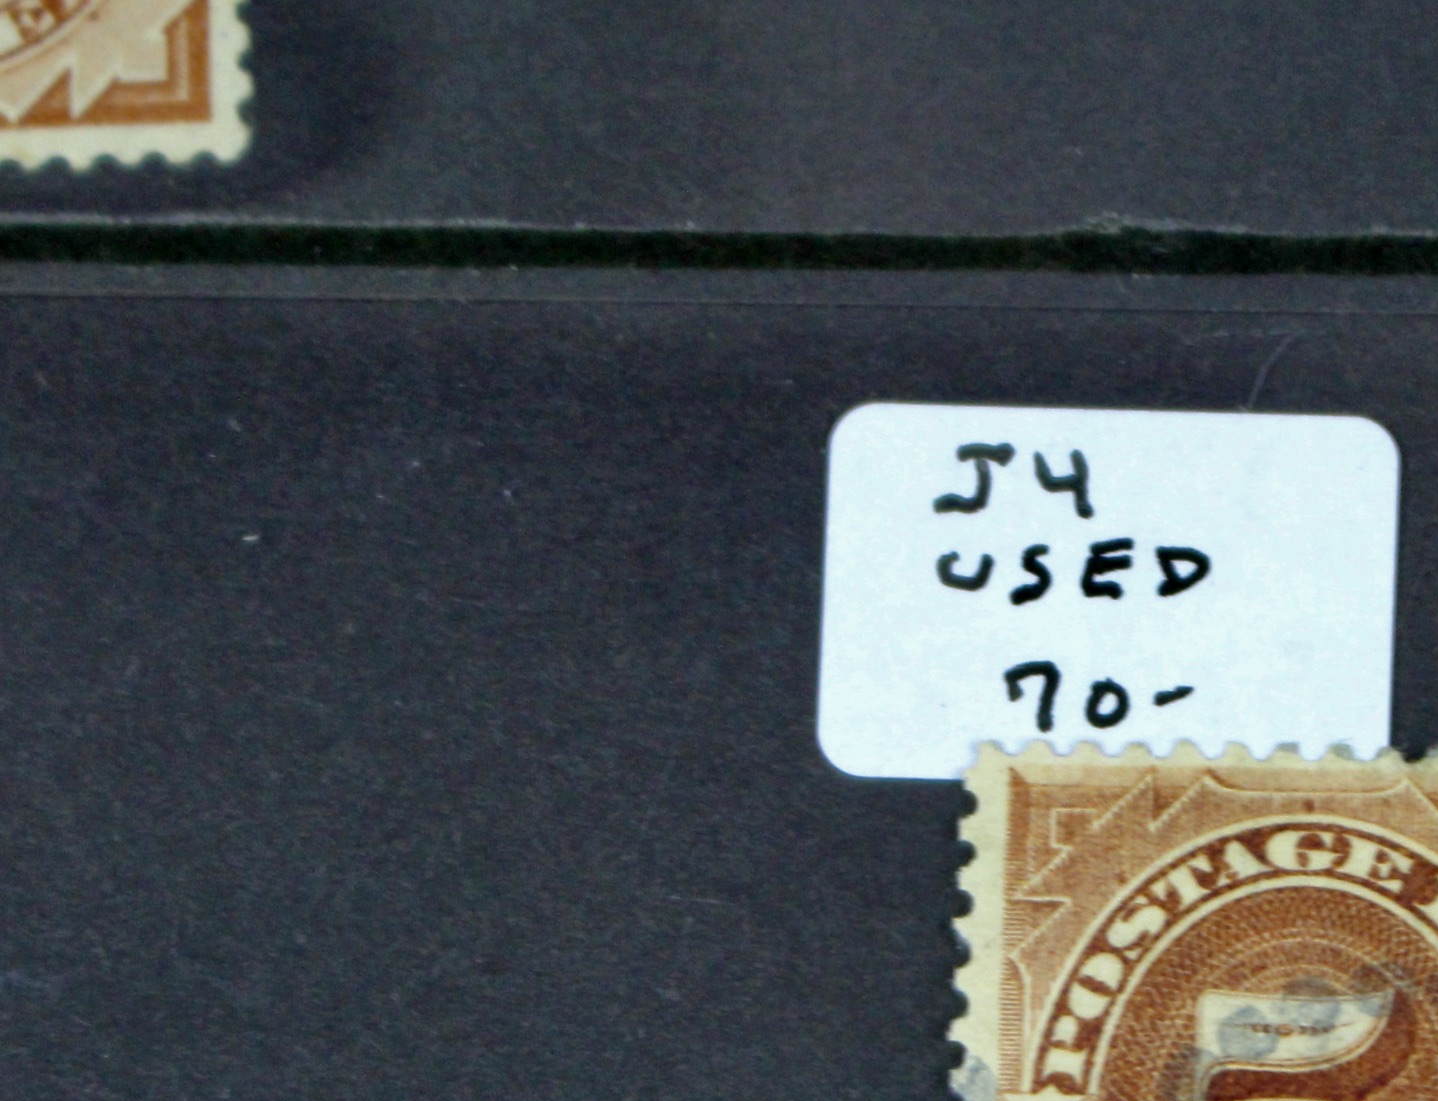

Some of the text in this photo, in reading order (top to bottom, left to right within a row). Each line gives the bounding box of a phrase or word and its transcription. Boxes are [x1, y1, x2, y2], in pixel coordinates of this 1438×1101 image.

[933, 443, 1095, 519] J4
[936, 538, 1212, 606] USED
[1040, 829, 1416, 1083] POSTAGE
